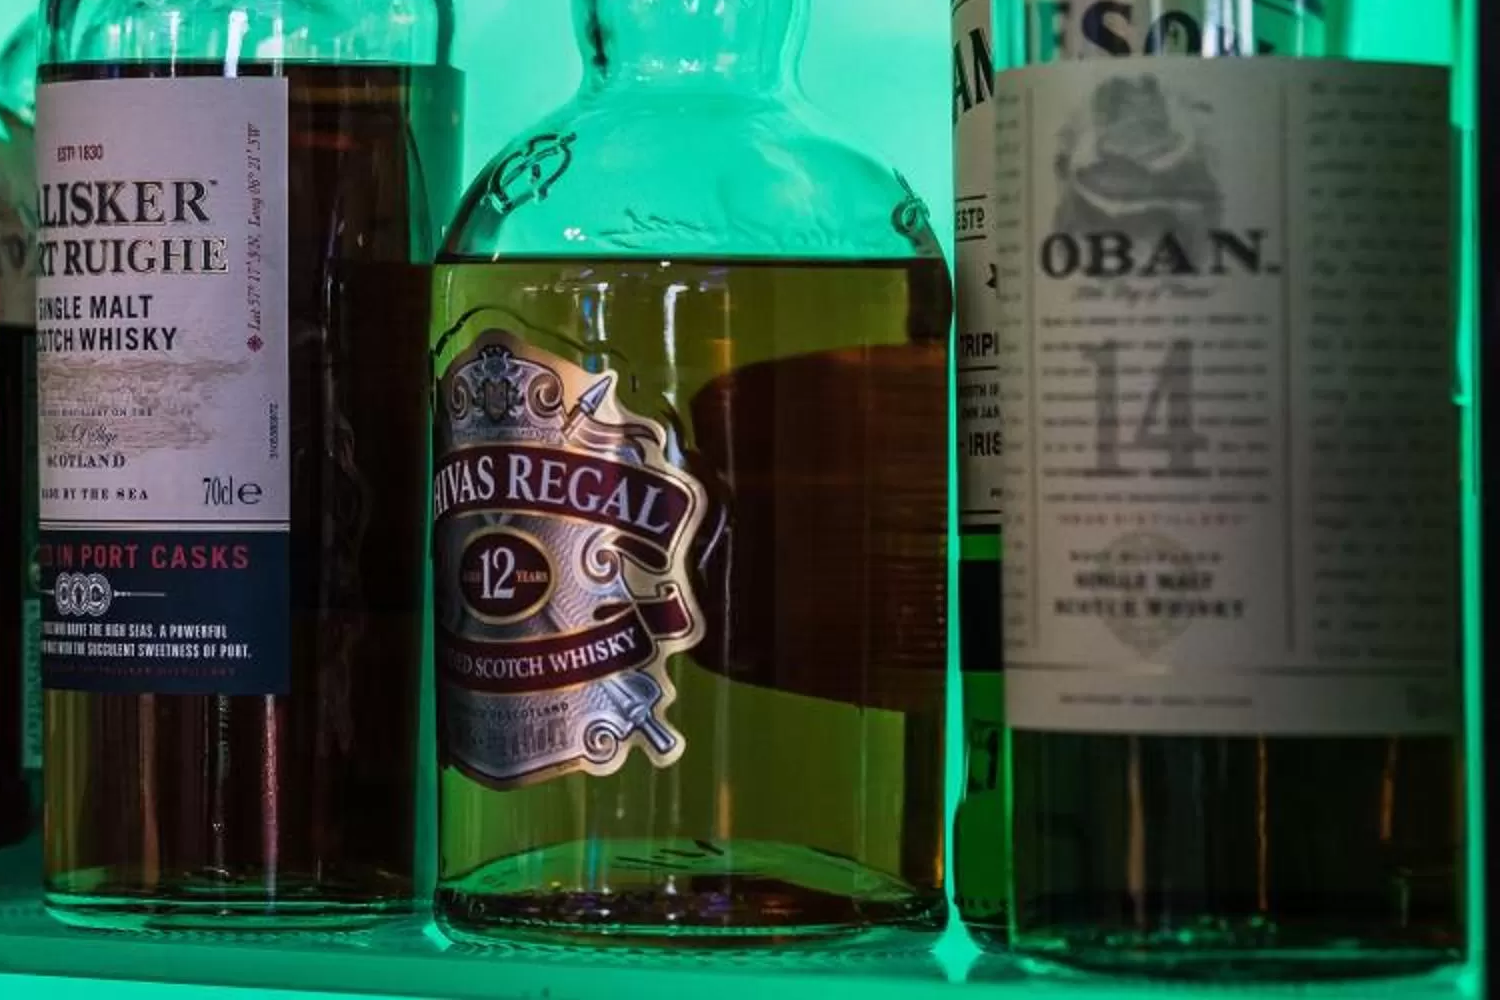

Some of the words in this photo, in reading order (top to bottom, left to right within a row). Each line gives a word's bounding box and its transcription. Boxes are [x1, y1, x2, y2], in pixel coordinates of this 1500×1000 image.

[37, 180, 210, 229] LISKER
[64, 238, 229, 277] RUIGHE
[89, 295, 153, 320] MALT
[79, 327, 178, 351] WHISKY
[1077, 337, 1209, 470] 14
[116, 487, 149, 501] SEA
[203, 476, 233, 507] 70cl
[507, 453, 670, 534] REGAL
[80, 543, 140, 570] PORT
[150, 544, 250, 570] CASKS
[479, 546, 517, 600] 12
[515, 568, 549, 584] YEARS
[169, 624, 229, 640] POWERFUL
[137, 643, 201, 659] SWEETNESS
[475, 655, 544, 680] SCOTCH
[548, 627, 637, 674] WHISKY
